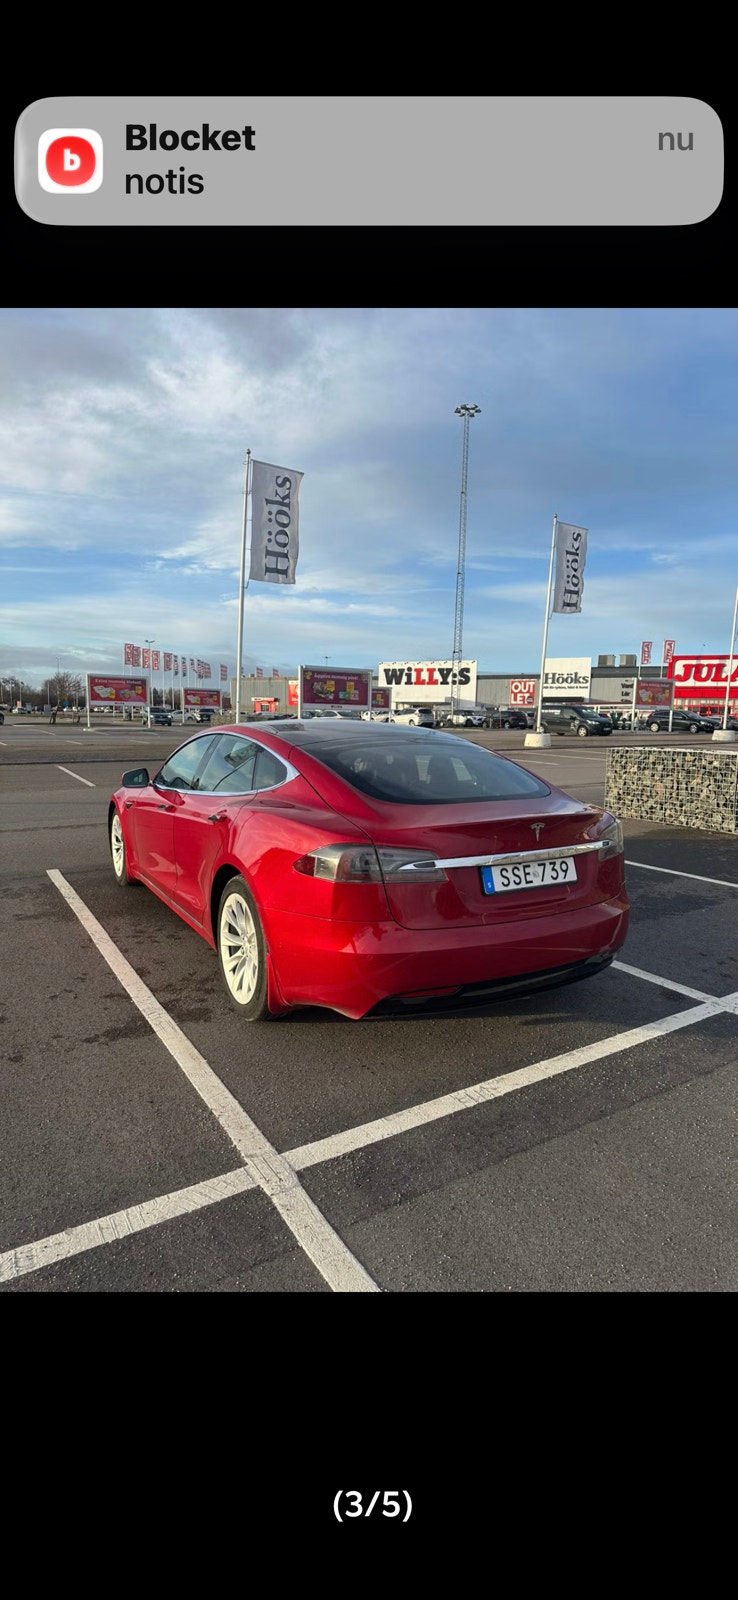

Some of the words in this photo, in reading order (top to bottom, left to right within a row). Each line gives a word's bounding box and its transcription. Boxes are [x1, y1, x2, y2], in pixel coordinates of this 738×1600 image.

[264, 475, 292, 578] Hööks
[562, 531, 582, 610] Hööks
[511, 681, 535, 693] OUT
[544, 672, 589, 685] Hööks
[511, 693, 530, 704] LET
[500, 864, 533, 887] SSE
[537, 860, 569, 882] 739
